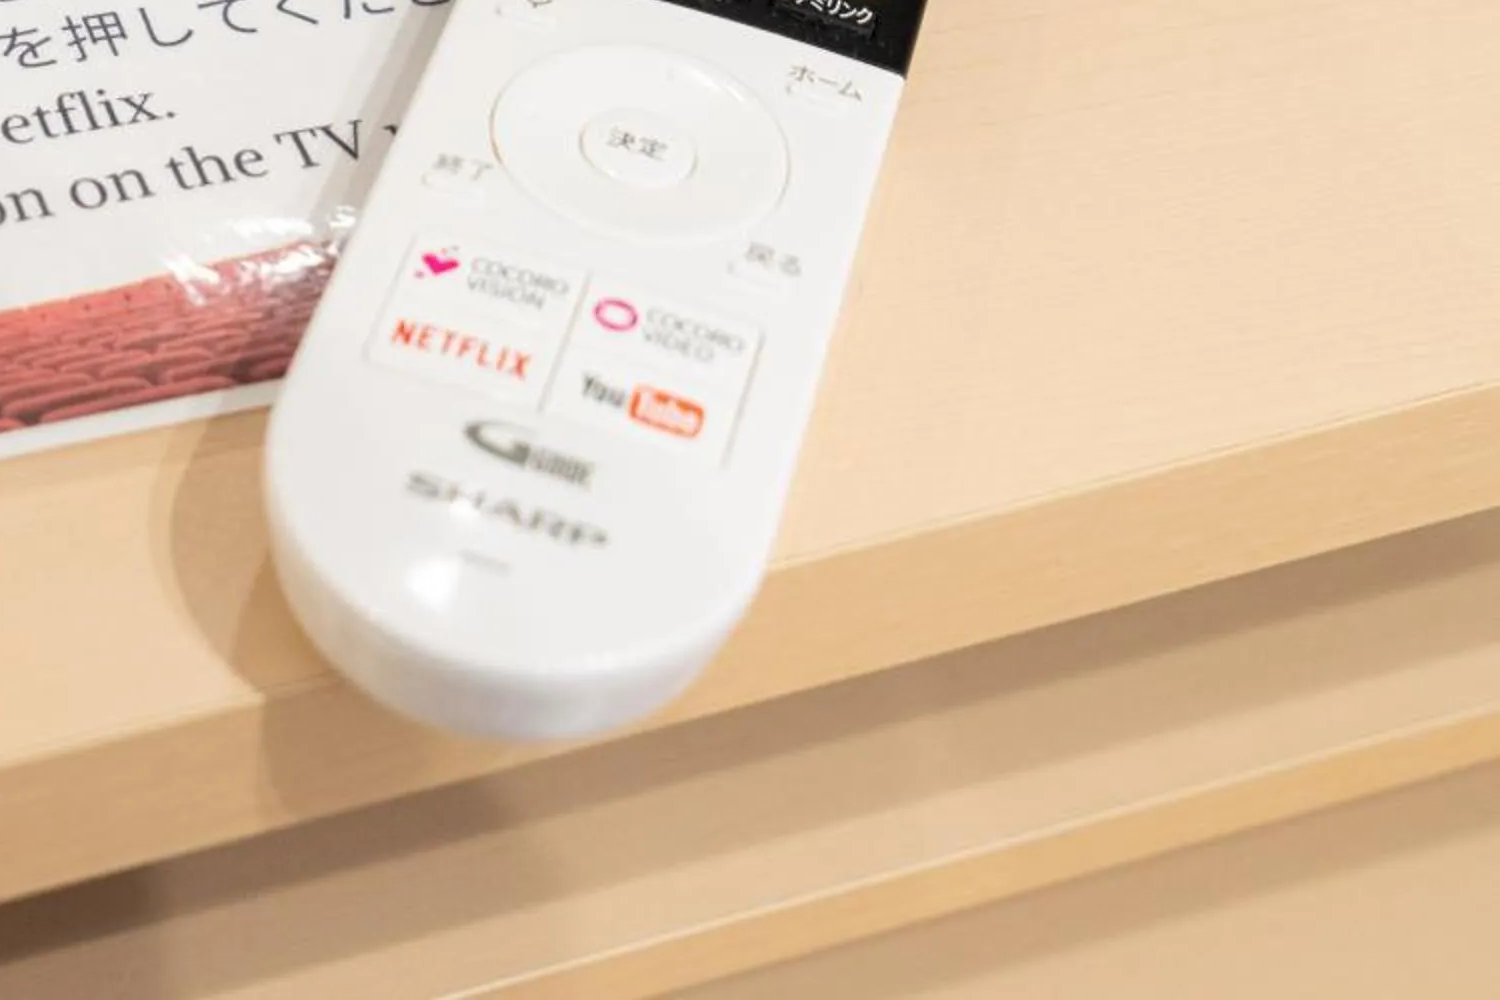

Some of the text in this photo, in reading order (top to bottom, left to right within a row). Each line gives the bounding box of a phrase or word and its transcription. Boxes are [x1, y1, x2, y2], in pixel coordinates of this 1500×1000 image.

[67, 167, 156, 212] on
[164, 138, 268, 191] the
[275, 118, 363, 170] TV
[605, 124, 669, 161] 決定
[390, 316, 531, 382] NETFLIX
